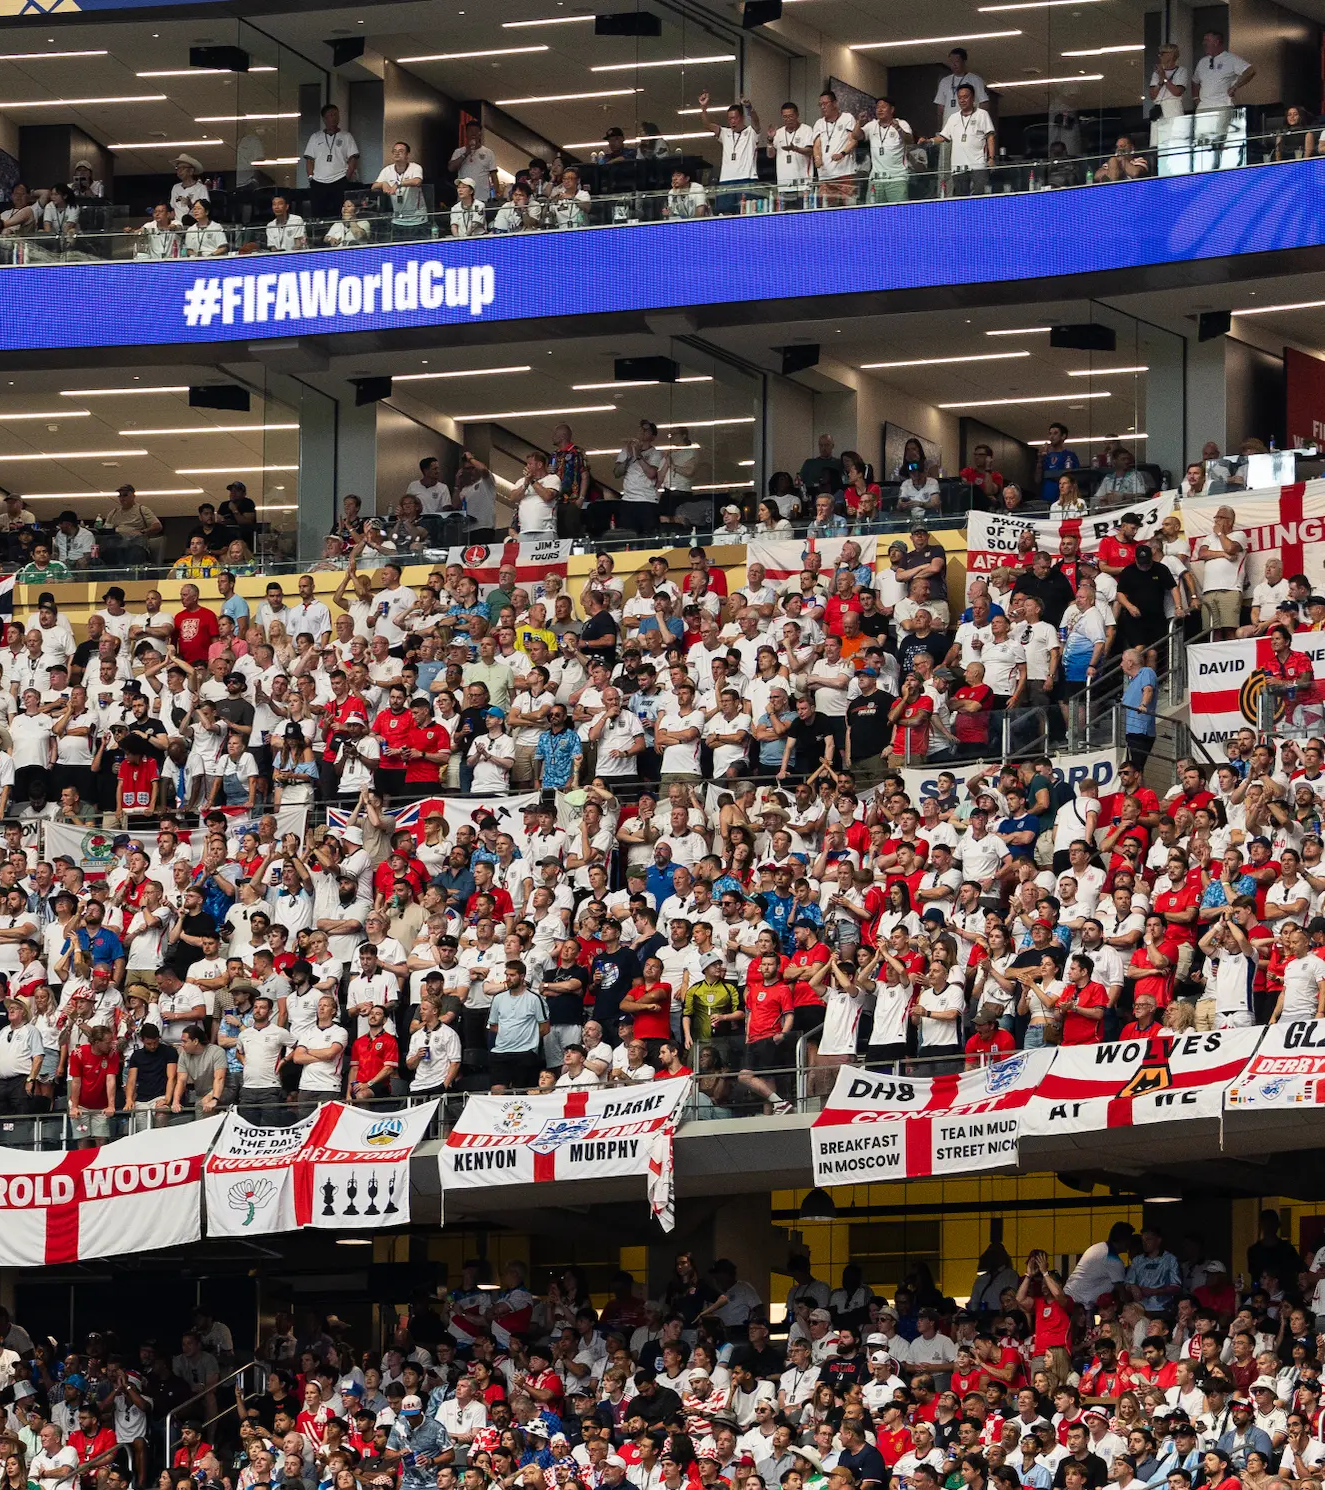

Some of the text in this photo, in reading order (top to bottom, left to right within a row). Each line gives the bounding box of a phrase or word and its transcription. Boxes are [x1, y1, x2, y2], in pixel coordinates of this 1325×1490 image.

[183, 260, 495, 326] #FIFAWorldCup
[986, 526, 1005, 537] OF
[535, 540, 560, 551] JIM'S
[987, 539, 1019, 550] SOU
[530, 551, 559, 561] TOURS
[1199, 660, 1245, 676] DAVID
[1095, 1032, 1222, 1065] WOLVES
[1257, 1056, 1321, 1074] DERBY
[847, 1079, 915, 1102] DH8
[602, 1094, 665, 1120] CLARKE
[850, 1096, 1007, 1124] CONSETT
[233, 1126, 275, 1138] THOSE
[461, 1119, 652, 1148] LUTON TOWN
[940, 1119, 1017, 1140] TEA IN MUD
[229, 1141, 302, 1156] MY FRIEND
[239, 1137, 267, 1148] THE
[569, 1139, 639, 1162] MURPHY
[820, 1134, 899, 1155] BREAKFAST
[936, 1143, 984, 1160] STREET
[353, 1148, 407, 1161] TOWN
[454, 1149, 517, 1172] KENYON
[819, 1153, 900, 1174] IN MOSCOW
[81, 1159, 190, 1198] WOOD
